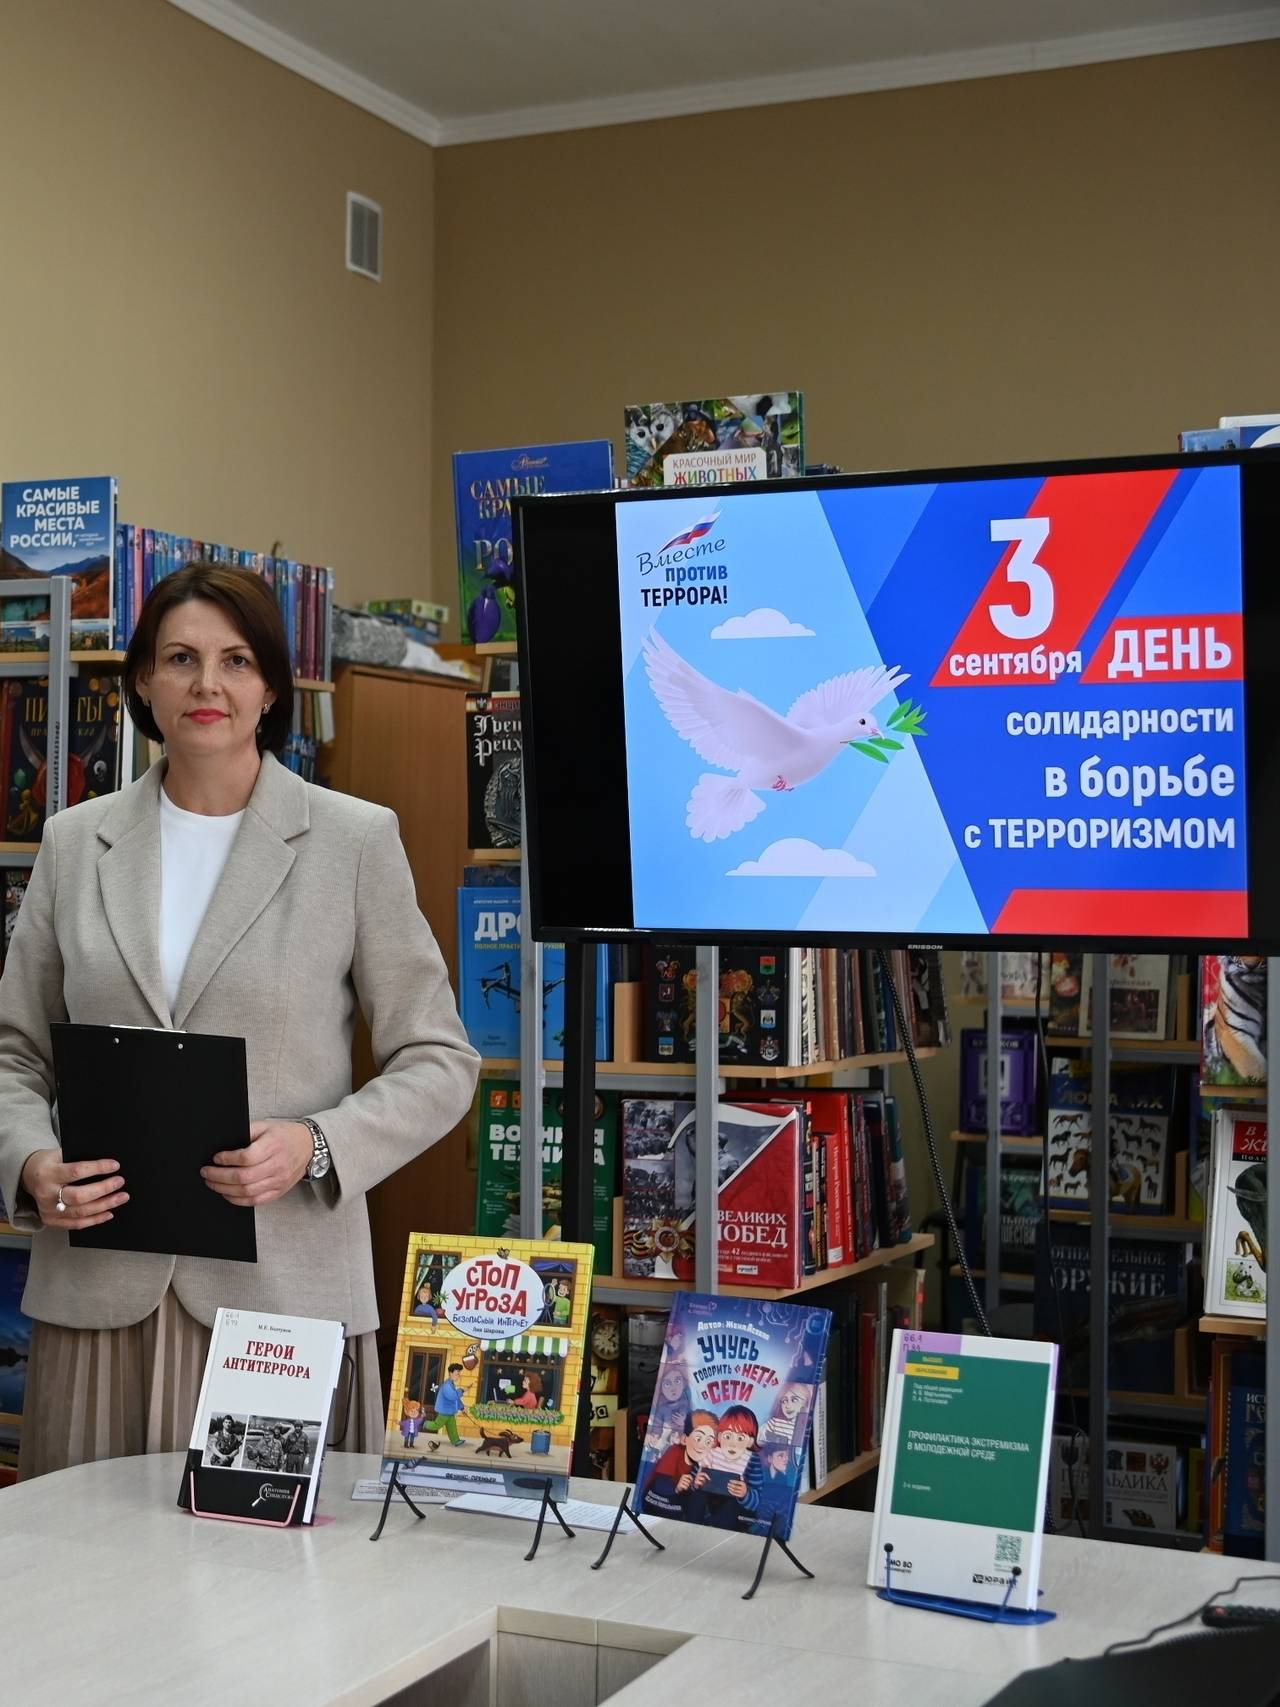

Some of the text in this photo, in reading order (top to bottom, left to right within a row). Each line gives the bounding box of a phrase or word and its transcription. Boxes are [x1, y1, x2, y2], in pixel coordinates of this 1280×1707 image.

[672, 452, 757, 469] КРАСОЧНЫЙ МИР
[673, 466, 757, 484] ЖИВОТНЫХ
[23, 486, 80, 502] САМЫЕ
[470, 476, 546, 501] САМЫЕ
[16, 501, 100, 518] КРАСИВЫЕ
[34, 517, 85, 532] МЕСТА
[10, 533, 77, 549] РОССИИ,
[636, 537, 727, 576] Вместе
[665, 564, 728, 586] против
[988, 516, 1056, 639] 3
[641, 585, 728, 608] ТЕРРОРА!
[948, 645, 1083, 682] сентября
[1106, 626, 1233, 679] ДЕНЬ
[1005, 706, 1234, 740] солидарности
[1079, 753, 1236, 806] борьбе
[989, 816, 1236, 850] ТЕРРОРИЗМОМ
[245, 1340, 295, 1361] ГЕРОИ
[697, 1333, 760, 1363] УЧУСЬ
[222, 1356, 311, 1379] АНТИТЕРРОРА
[734, 1363, 779, 1388] «НЕТ!»
[707, 1379, 754, 1405] СЕТИ
[908, 1430, 1030, 1453] ПРОФИЛАКТИКА ЭКСТРЕМИЗМА
[971, 1448, 997, 1462] СРЕДЕ
